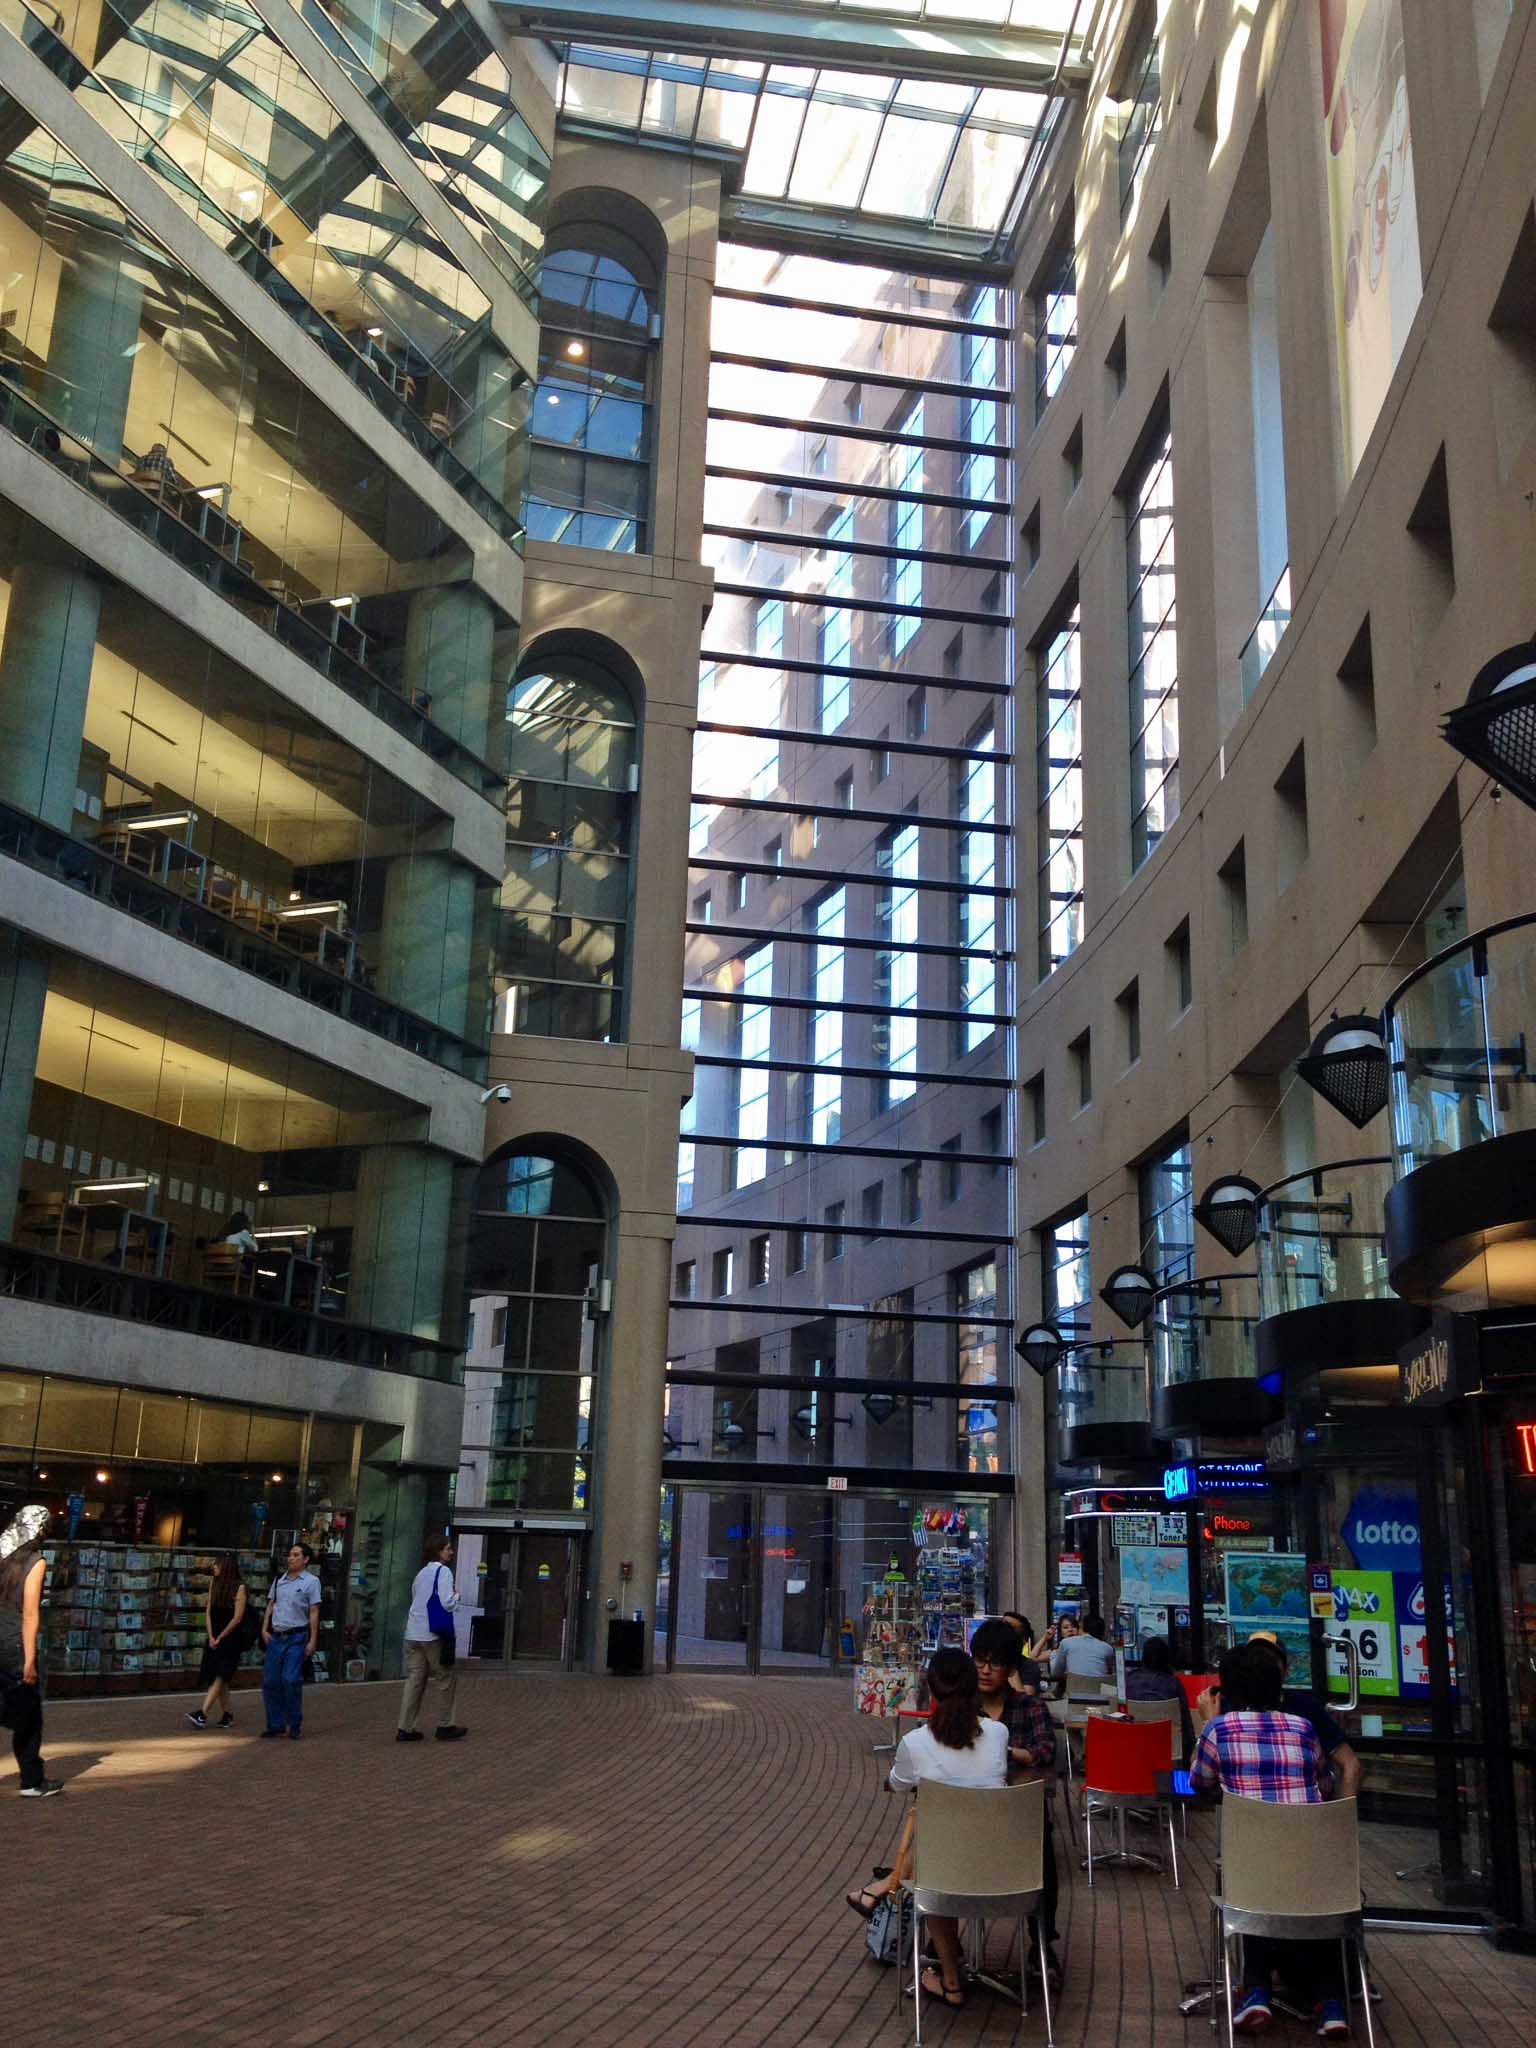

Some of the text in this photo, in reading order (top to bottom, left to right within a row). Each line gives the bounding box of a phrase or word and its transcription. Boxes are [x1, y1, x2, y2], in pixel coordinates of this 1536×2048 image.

[1516, 1425, 1536, 1473] T
[831, 1478, 845, 1489] EXIT
[1214, 1515, 1250, 1530] Phone
[1159, 1533, 1181, 1542] Toner
[1333, 1586, 1376, 1611] MAX
